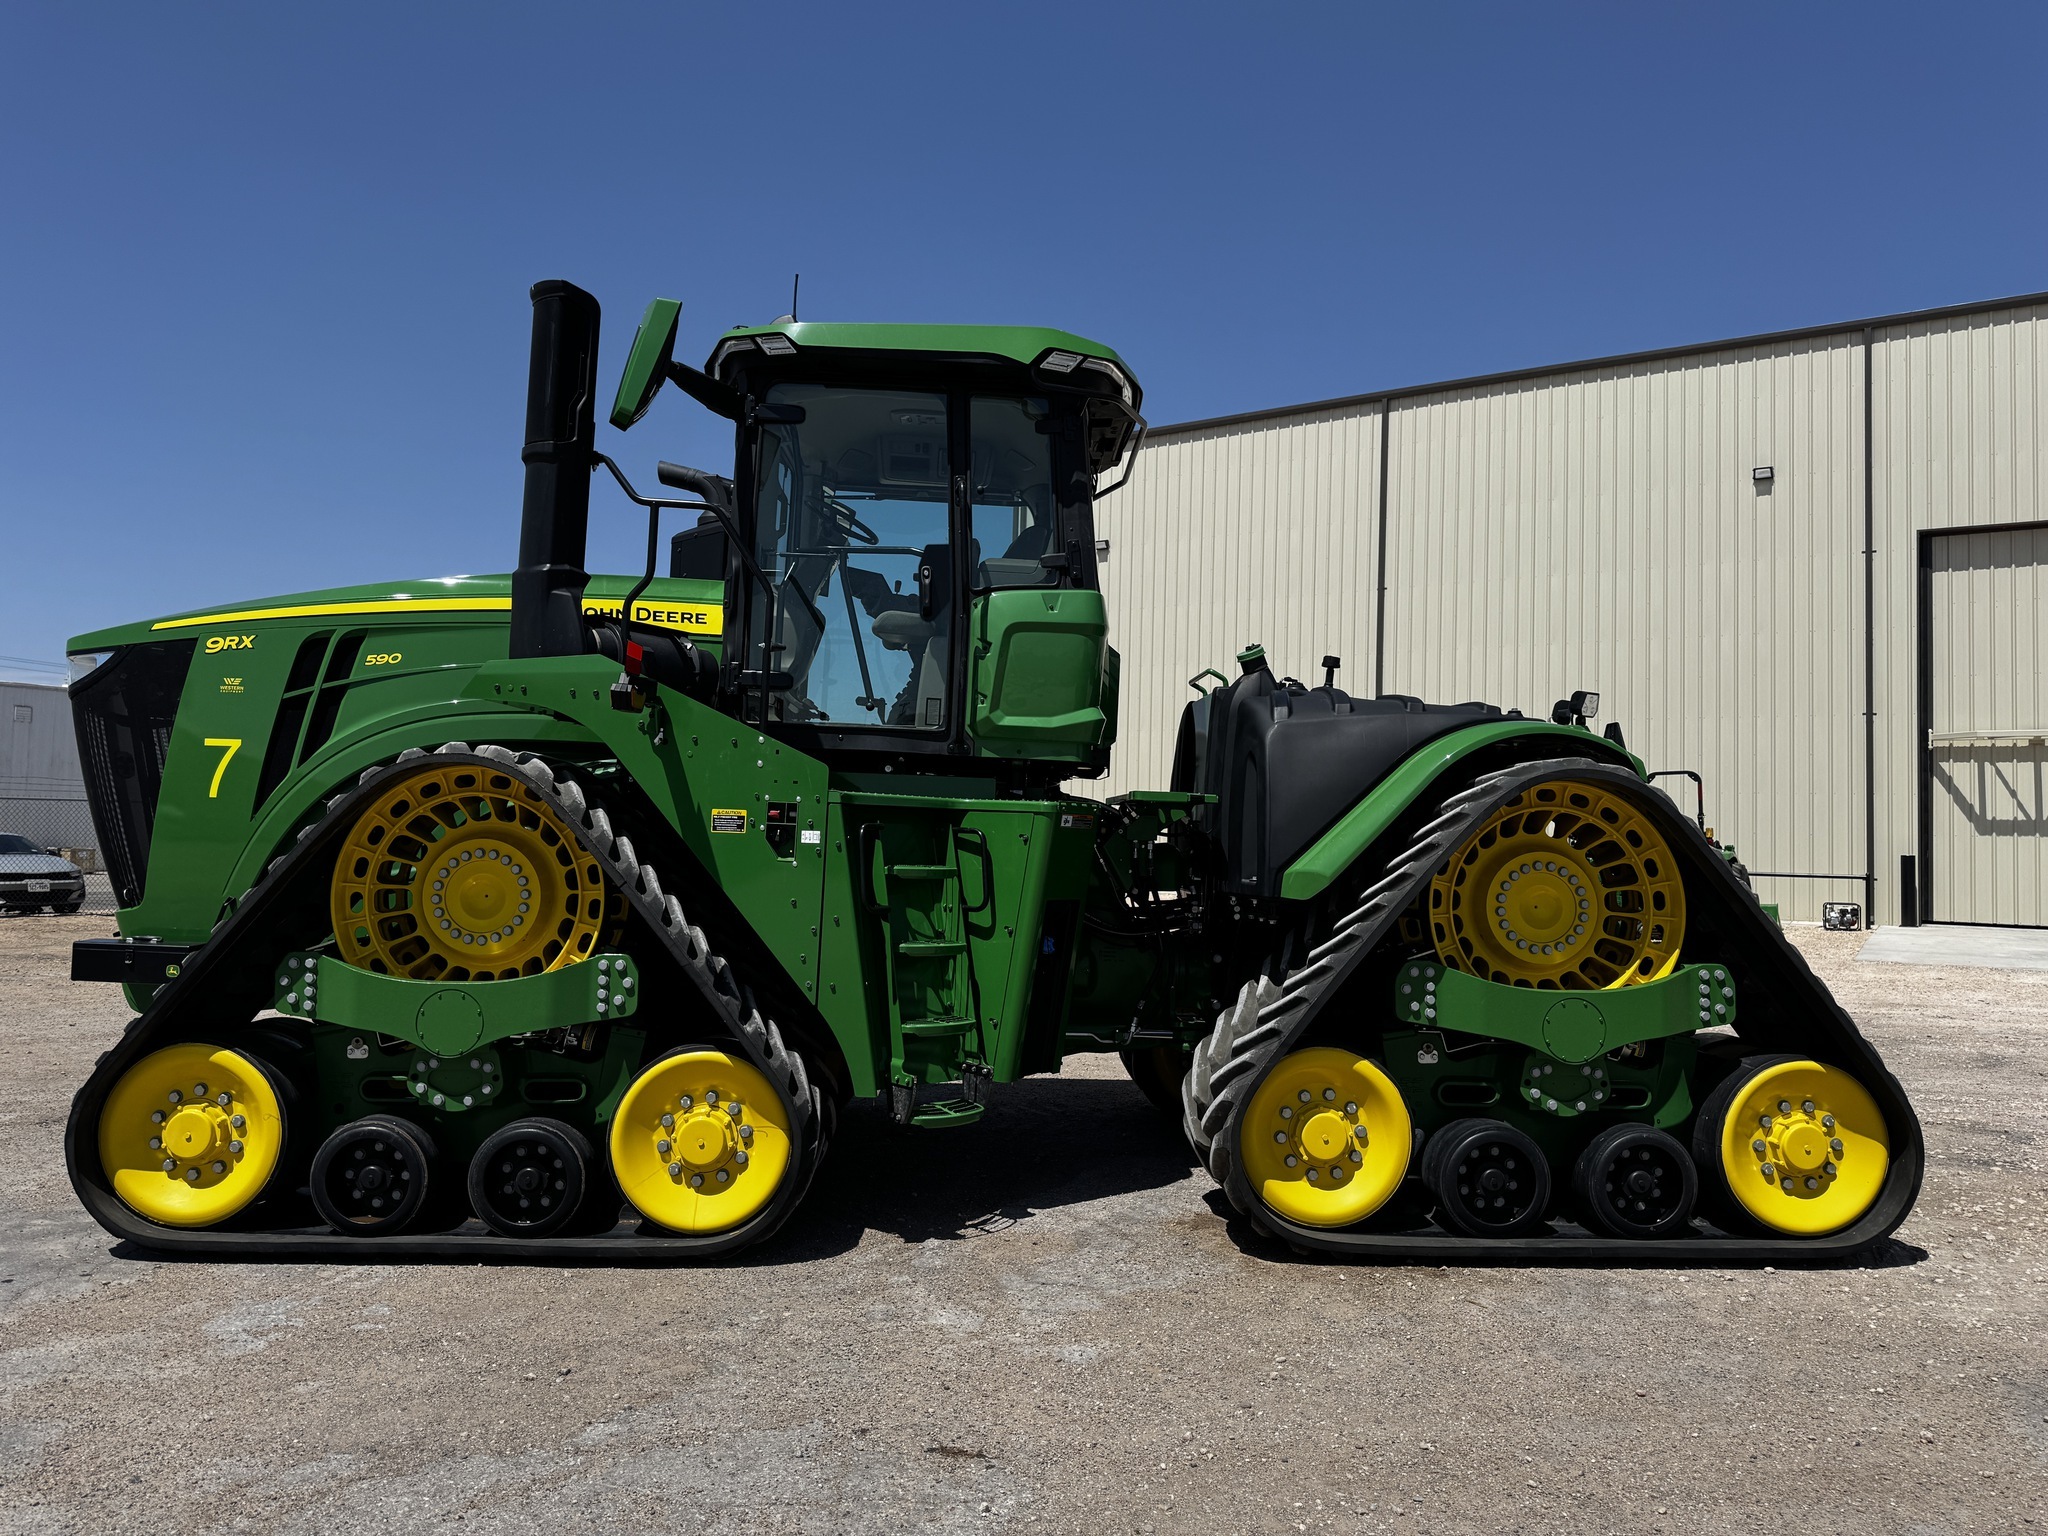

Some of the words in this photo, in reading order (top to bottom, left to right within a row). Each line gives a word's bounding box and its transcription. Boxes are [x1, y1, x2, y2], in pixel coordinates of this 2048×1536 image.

[635, 607, 707, 625] DEERE
[205, 635, 257, 654] 9RX
[364, 652, 402, 666] 590
[204, 738, 242, 798] 7
